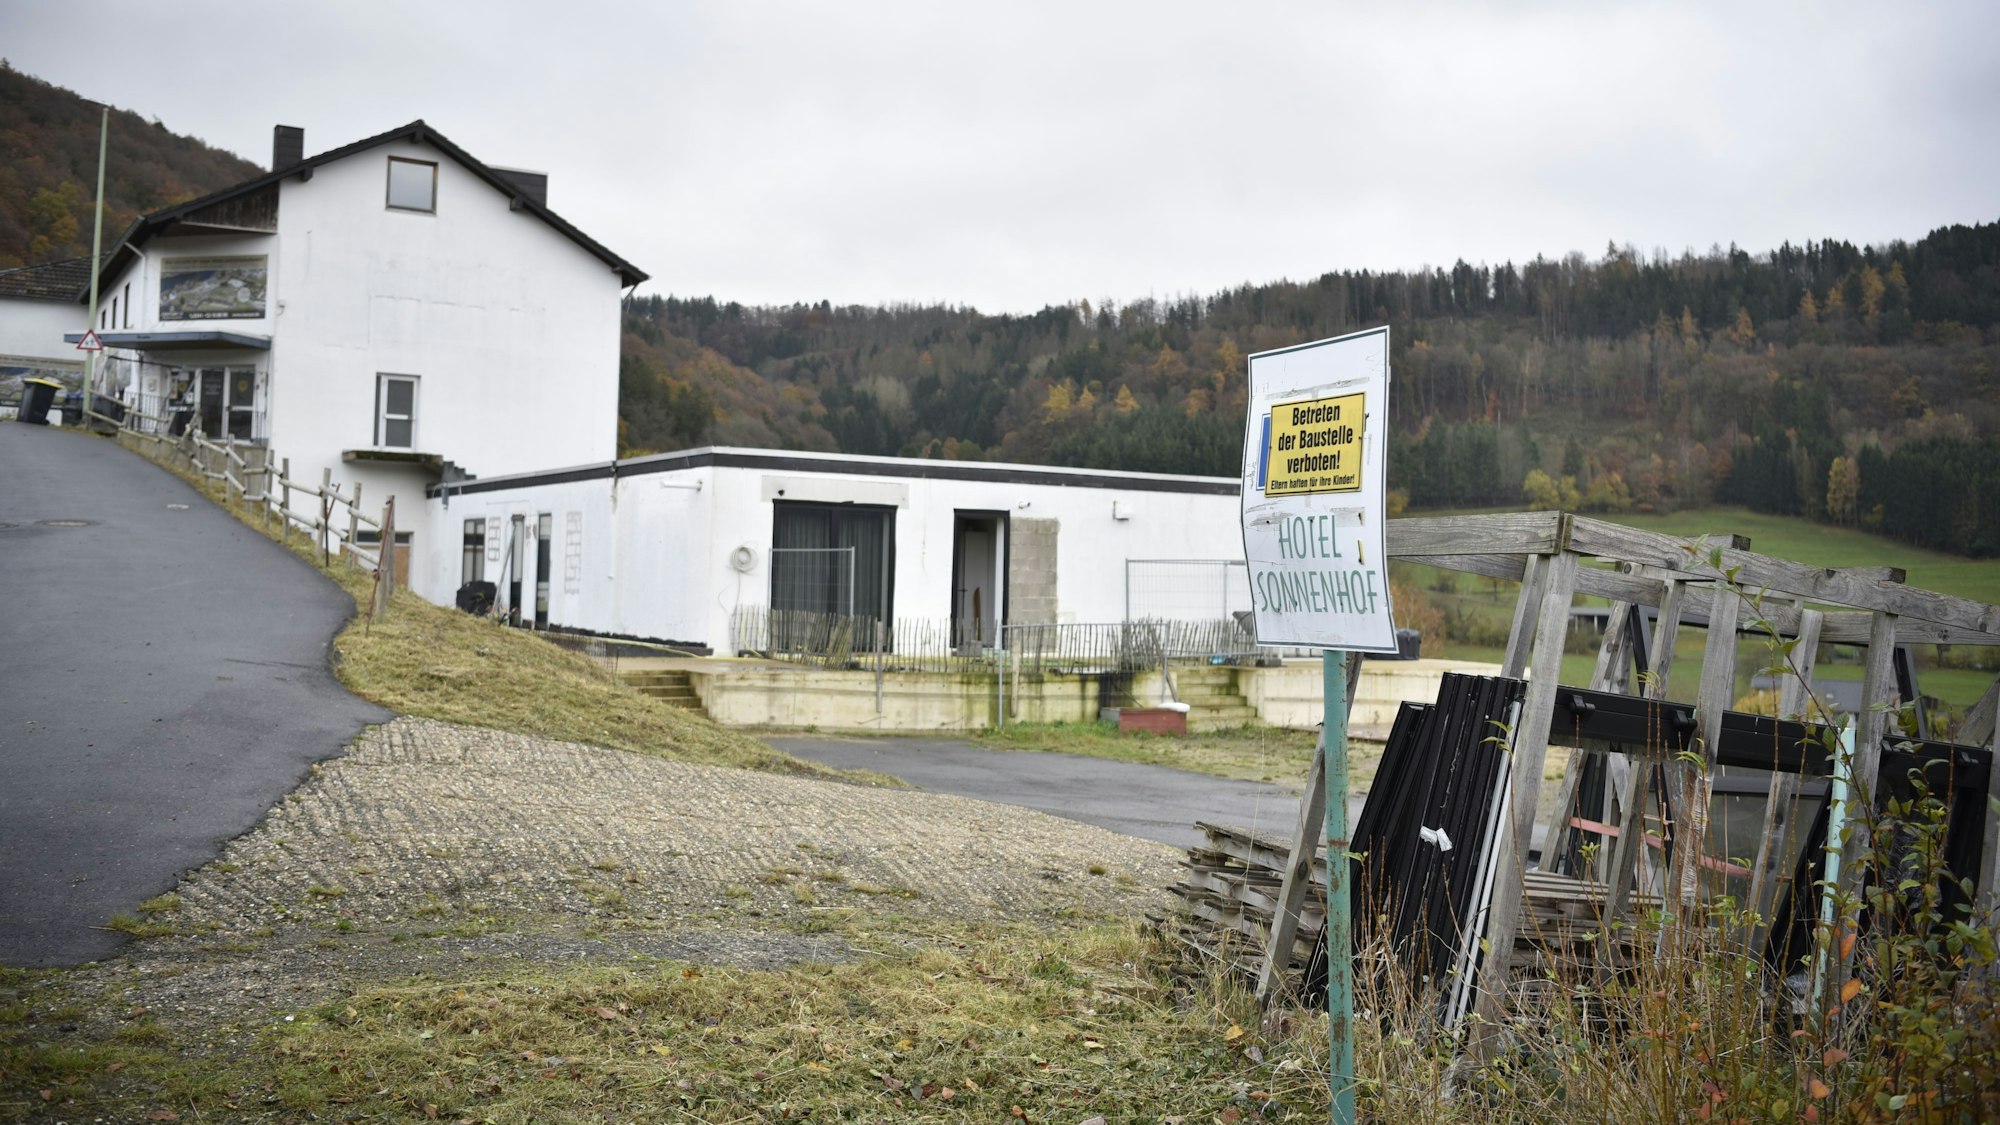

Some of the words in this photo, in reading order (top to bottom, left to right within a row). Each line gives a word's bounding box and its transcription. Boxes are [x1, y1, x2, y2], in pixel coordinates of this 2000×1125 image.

[1292, 404, 1341, 426] Betreten
[1278, 432, 1296, 451] der
[1299, 425, 1353, 449] Baustelle
[1287, 449, 1341, 474] verboten!
[1271, 480, 1288, 490] Eltern
[1289, 478, 1308, 489] haften
[1309, 476, 1318, 487] für
[1332, 473, 1355, 486] Kinder!
[1279, 514, 1342, 559] HOTEL
[1256, 569, 1377, 615] SONNENHOF
